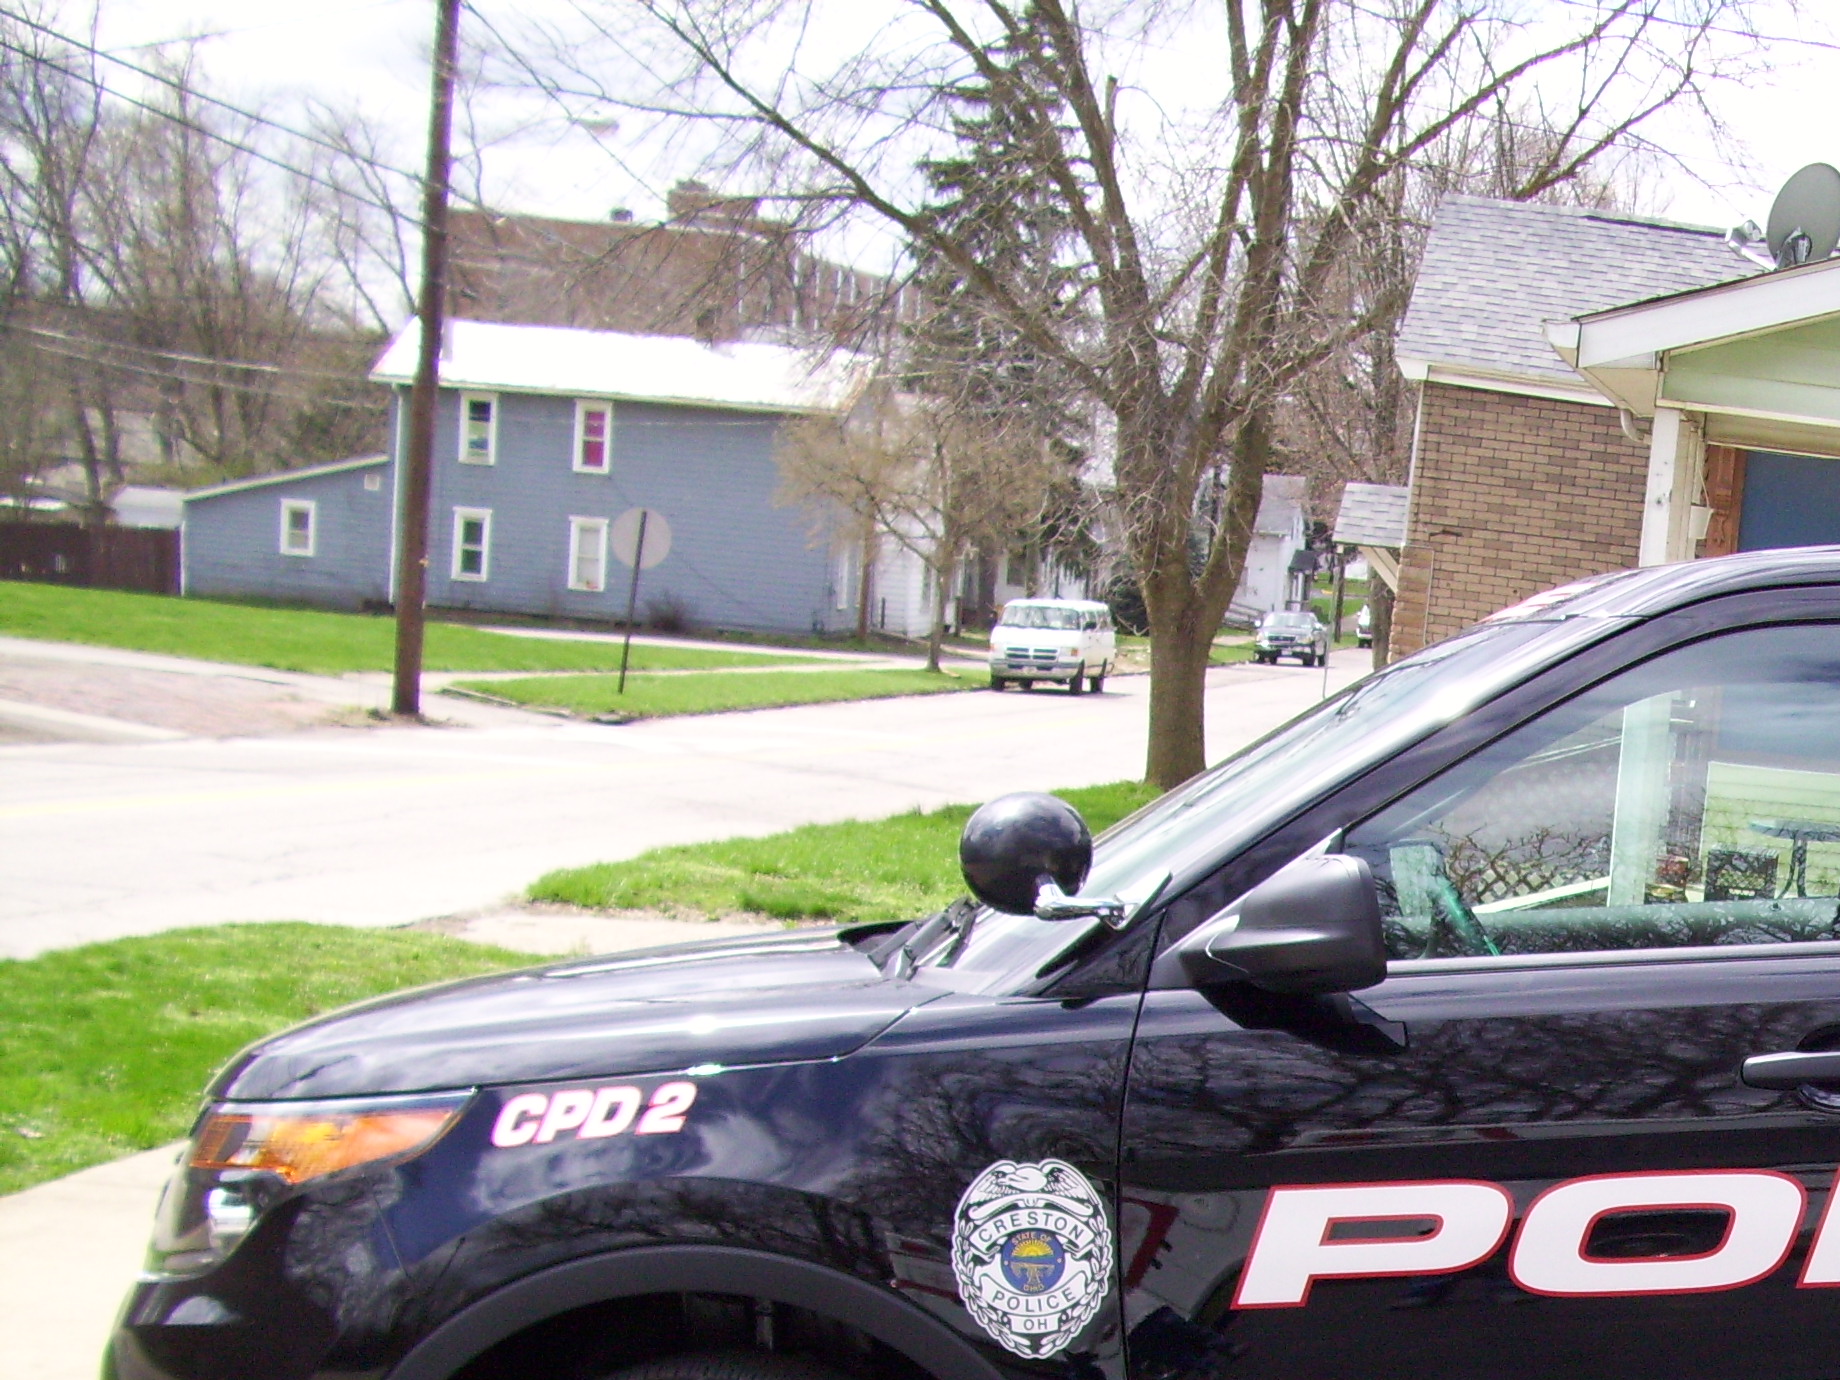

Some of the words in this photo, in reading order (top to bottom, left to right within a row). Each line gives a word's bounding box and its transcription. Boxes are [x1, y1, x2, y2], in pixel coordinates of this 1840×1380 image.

[490, 1085, 642, 1148] CPD
[635, 1081, 697, 1136] 2
[978, 1212, 1085, 1243] CRESTON
[992, 1287, 1076, 1313] POLICE
[1023, 1318, 1048, 1331] OH
